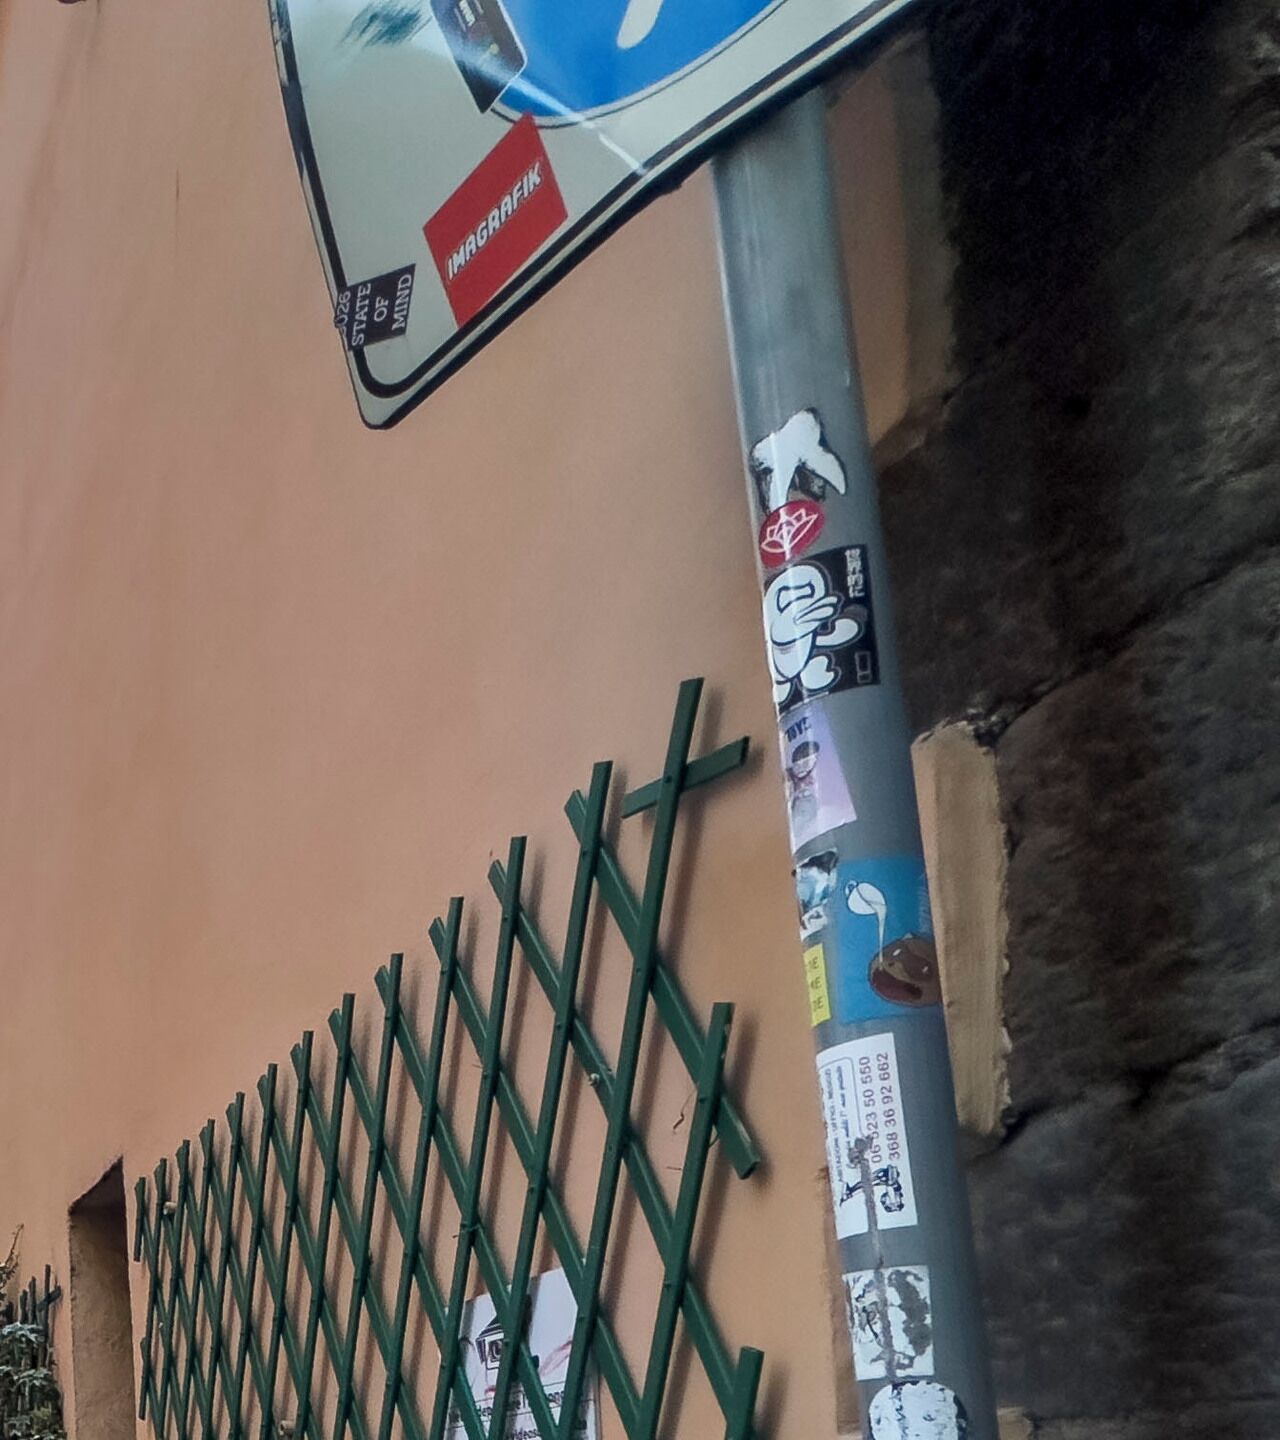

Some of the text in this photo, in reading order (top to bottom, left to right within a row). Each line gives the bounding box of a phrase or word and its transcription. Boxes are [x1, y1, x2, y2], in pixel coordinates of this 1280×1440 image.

[447, 161, 541, 281] IMAGRAFIK
[352, 283, 371, 346] STATE
[374, 297, 389, 322] OF
[392, 274, 412, 331] MIND
[863, 1089, 876, 1107] 50
[880, 1085, 893, 1104] 92
[883, 1108, 896, 1128] 36
